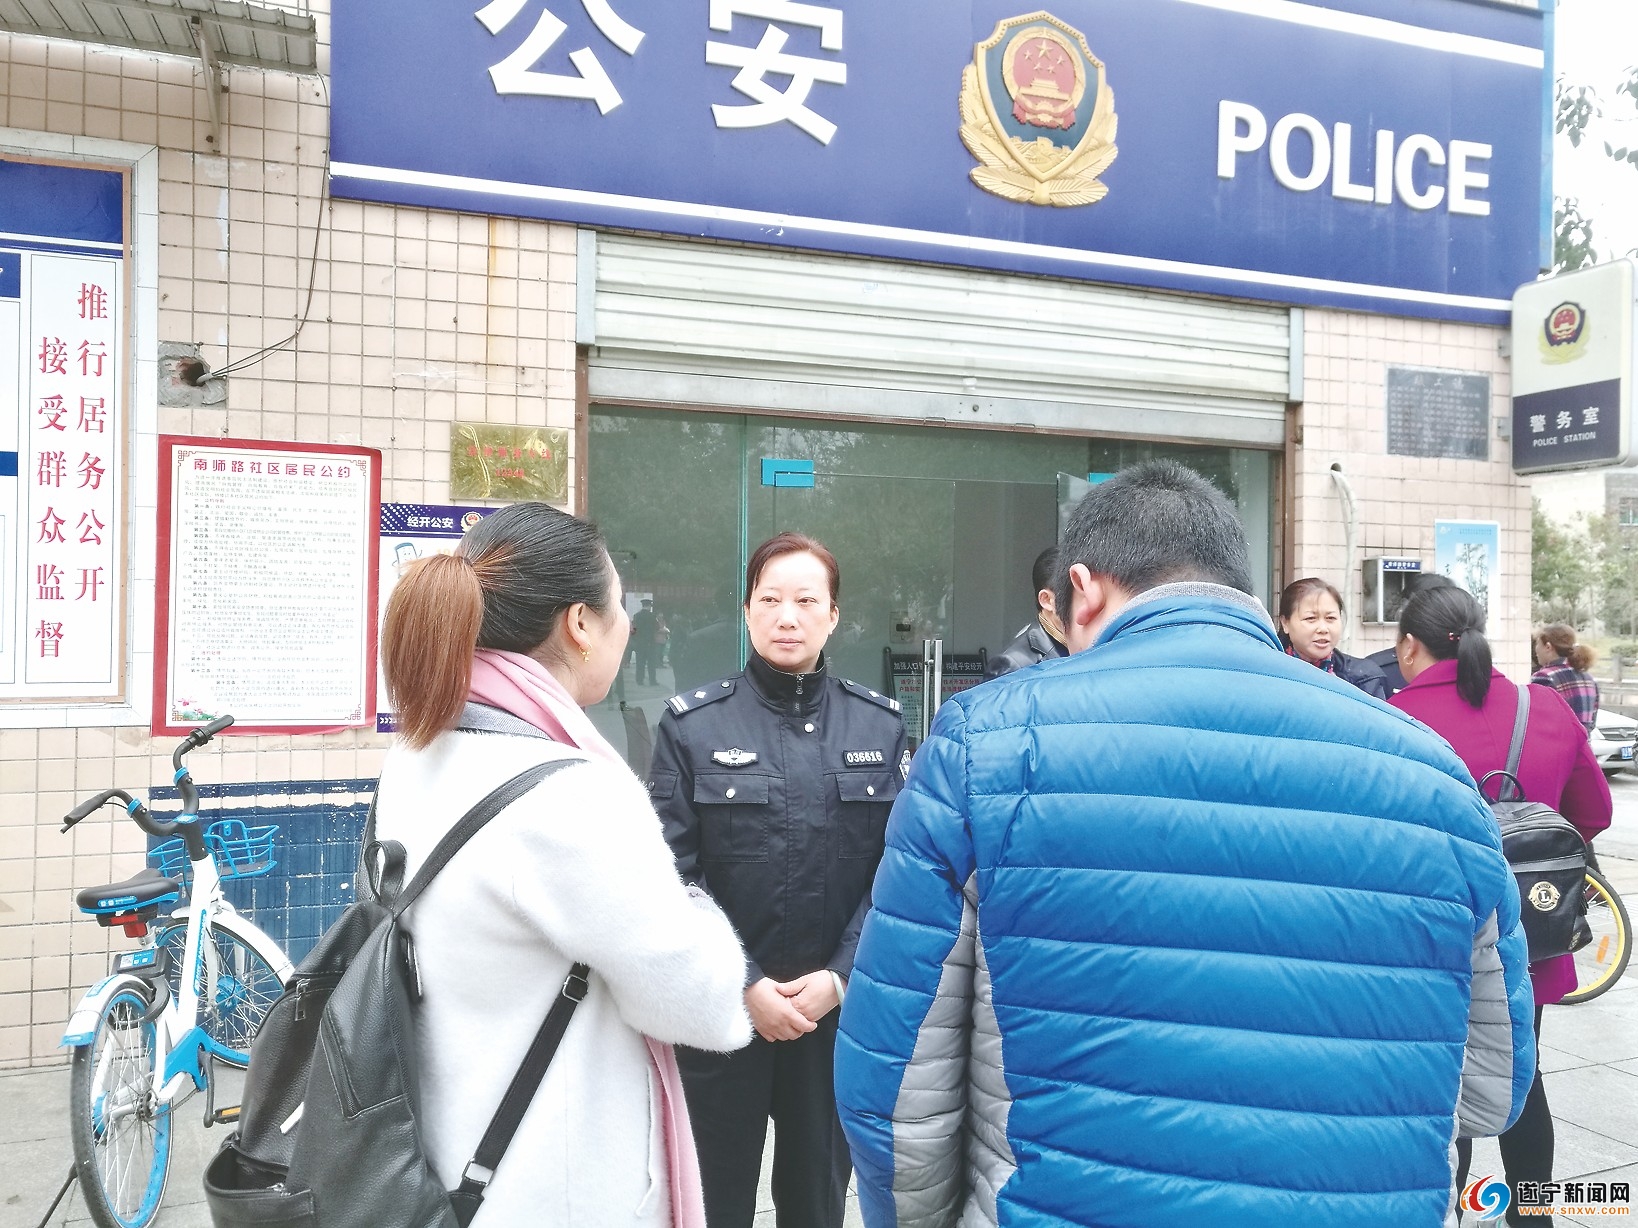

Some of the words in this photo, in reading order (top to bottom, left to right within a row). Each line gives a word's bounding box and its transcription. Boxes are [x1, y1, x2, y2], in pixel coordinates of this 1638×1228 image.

[474, 0, 847, 146] 公安
[1217, 99, 1493, 216] POLICE
[1529, 406, 1600, 433] 警务室
[75, 281, 109, 602] 推行居务公开
[1532, 436, 1558, 447] POLICE
[1563, 431, 1597, 443] STATION
[193, 458, 351, 478] 南师路社区居民公约
[34, 336, 68, 659] 接受群众监督
[407, 515, 454, 529] 经开公安
[846, 751, 883, 763] 036616
